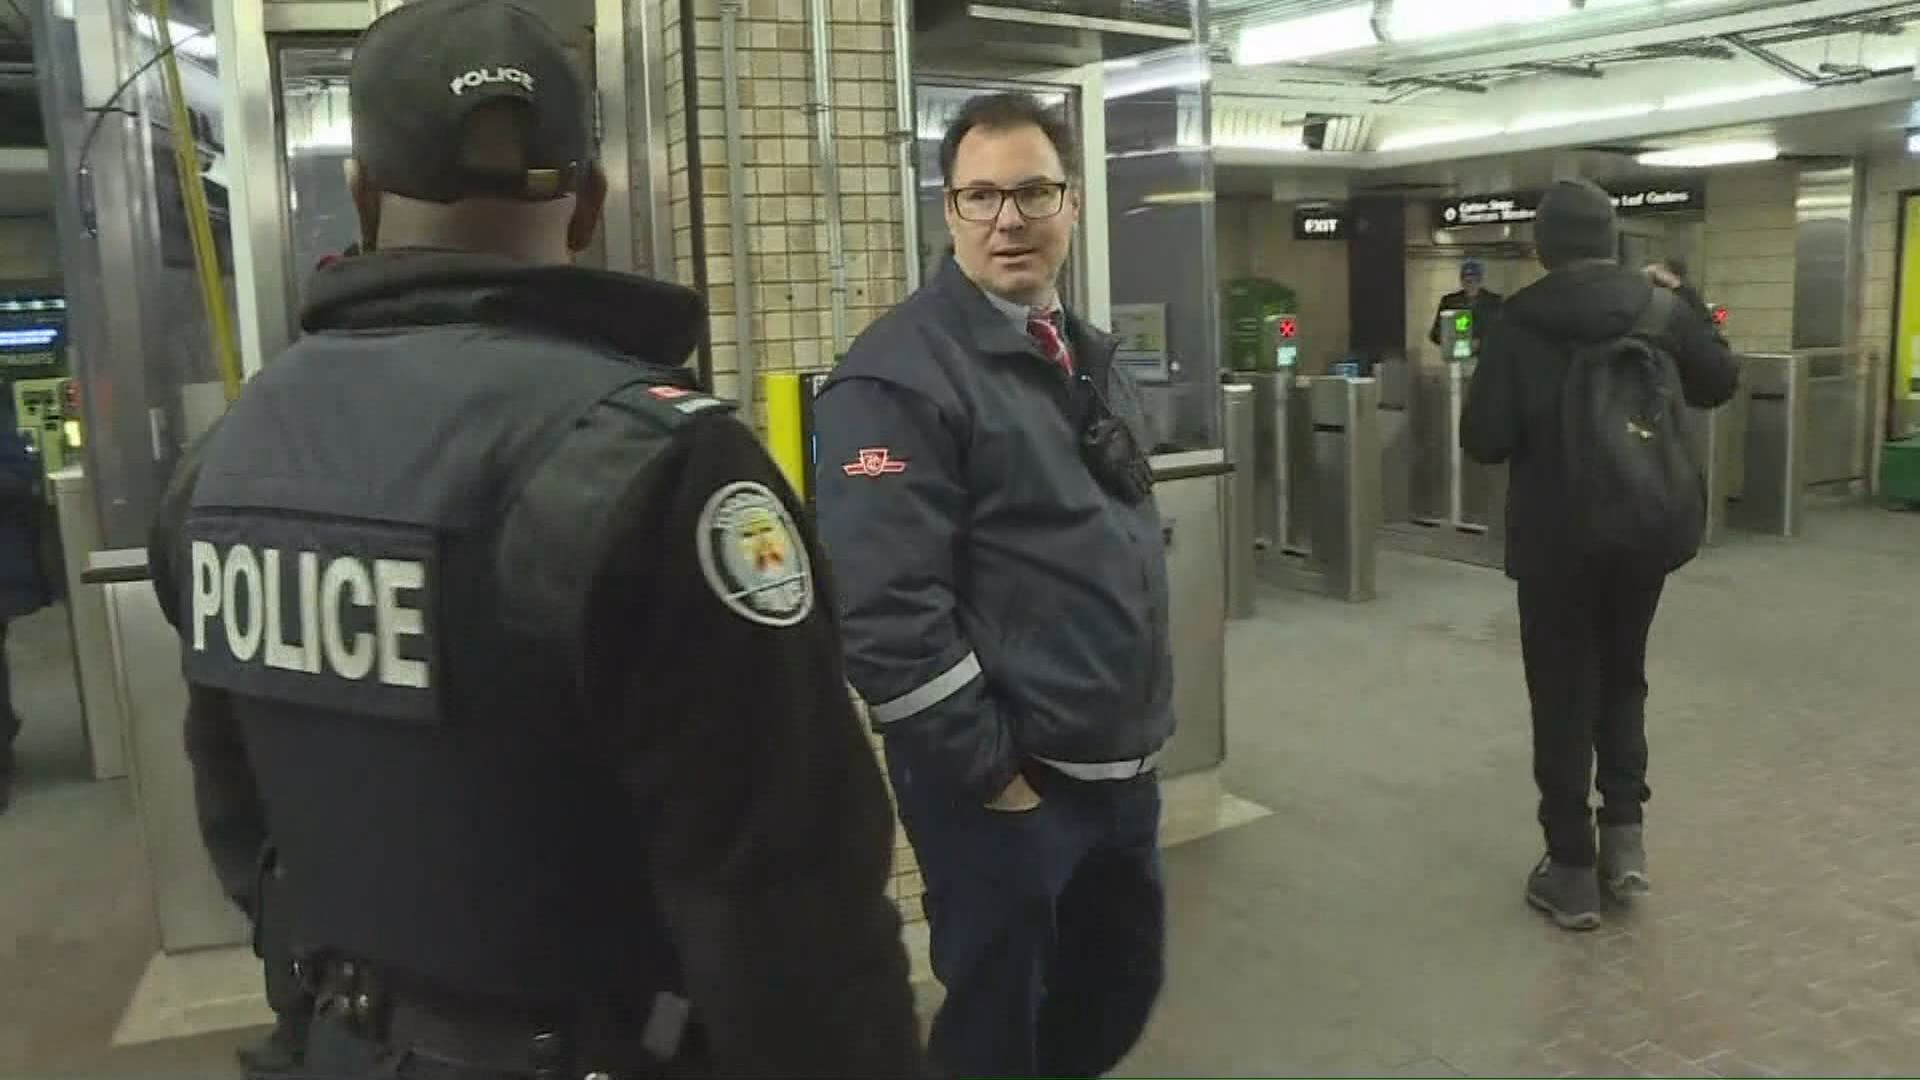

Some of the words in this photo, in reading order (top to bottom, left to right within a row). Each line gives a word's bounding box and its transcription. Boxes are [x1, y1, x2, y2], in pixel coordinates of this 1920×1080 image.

[449, 67, 534, 96] POLICE
[1304, 218, 1338, 233] EXIT
[191, 539, 429, 688] POLICE
